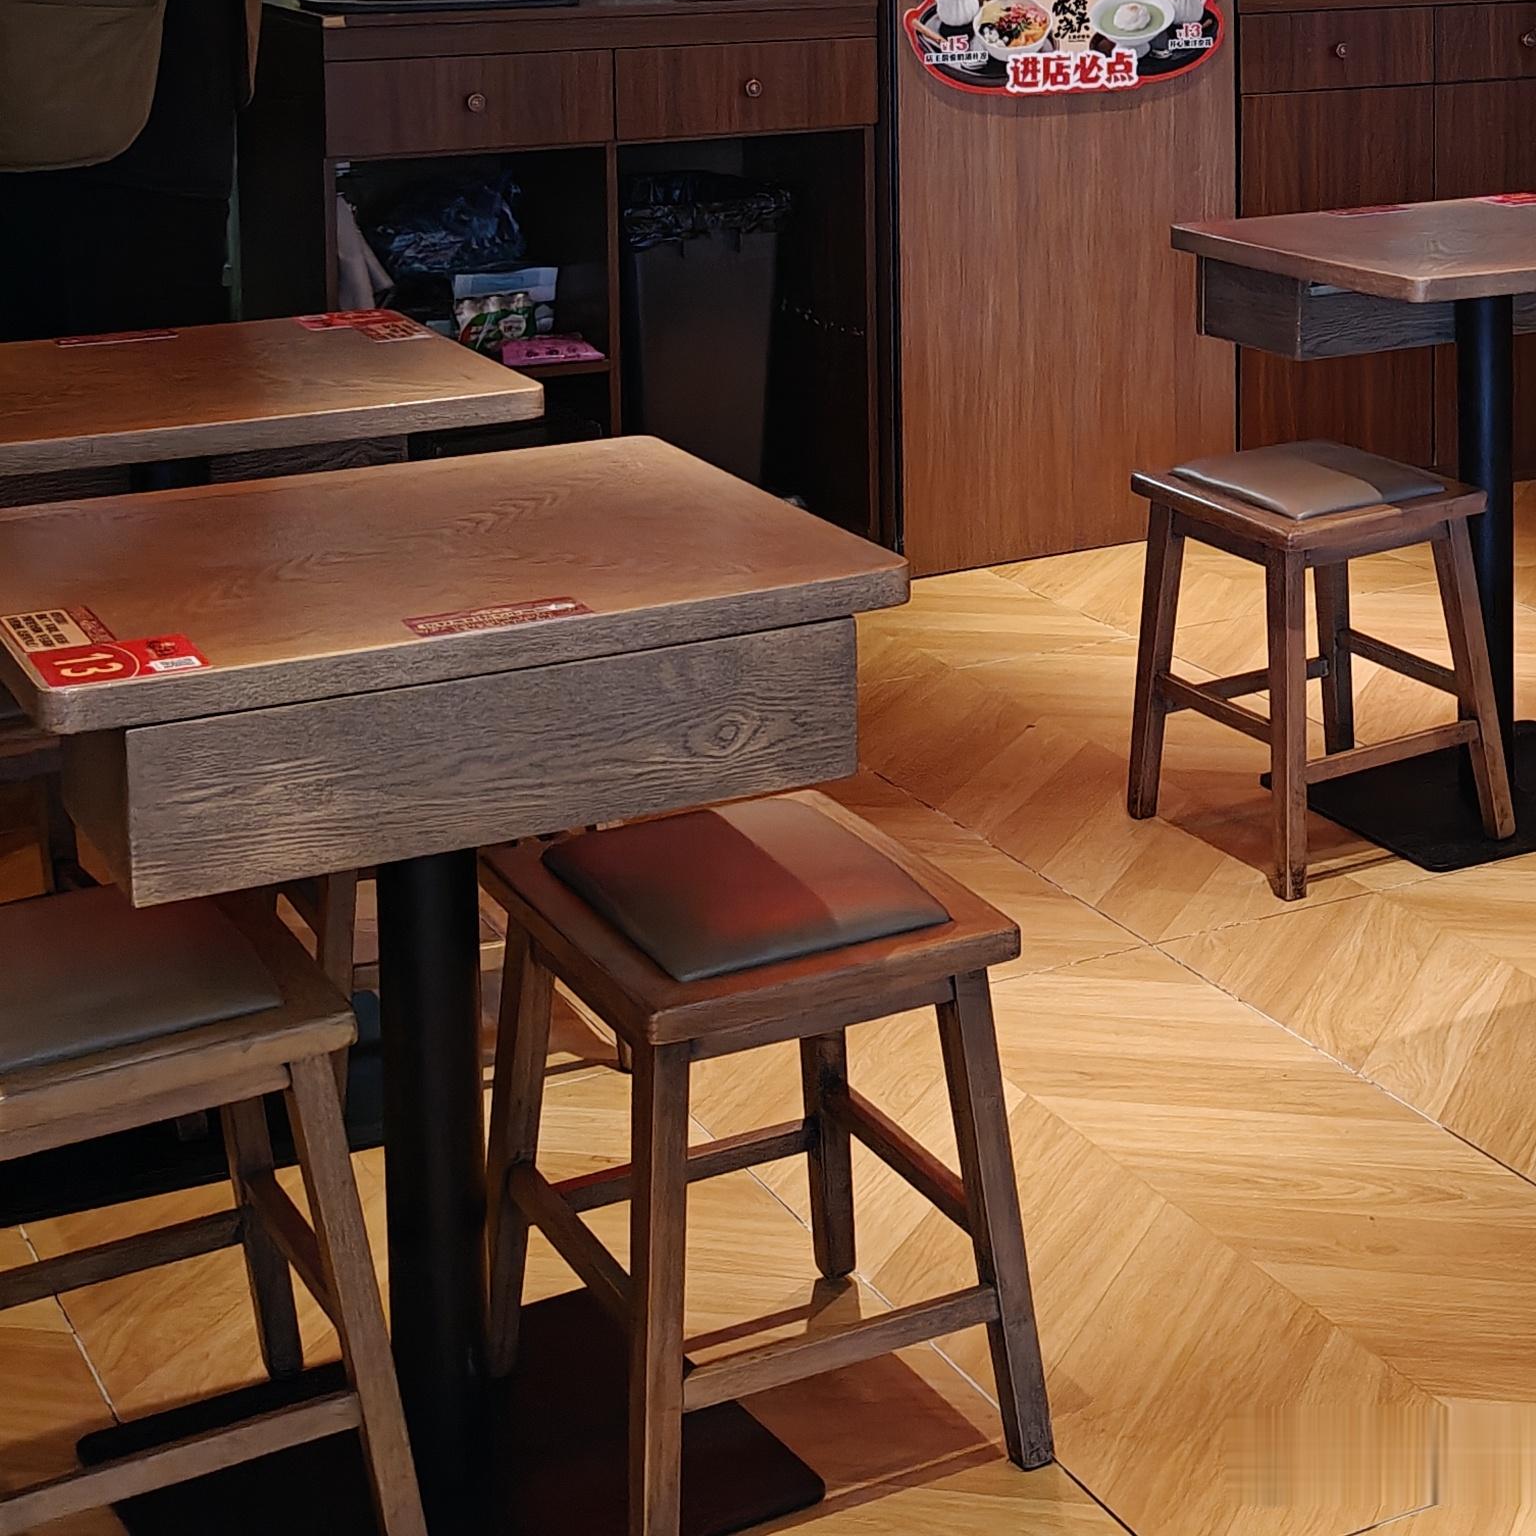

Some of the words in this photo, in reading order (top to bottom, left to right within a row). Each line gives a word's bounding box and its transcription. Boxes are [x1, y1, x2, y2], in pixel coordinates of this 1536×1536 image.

[1010, 52, 1136, 89] 进店必点
[53, 652, 124, 678] 13
